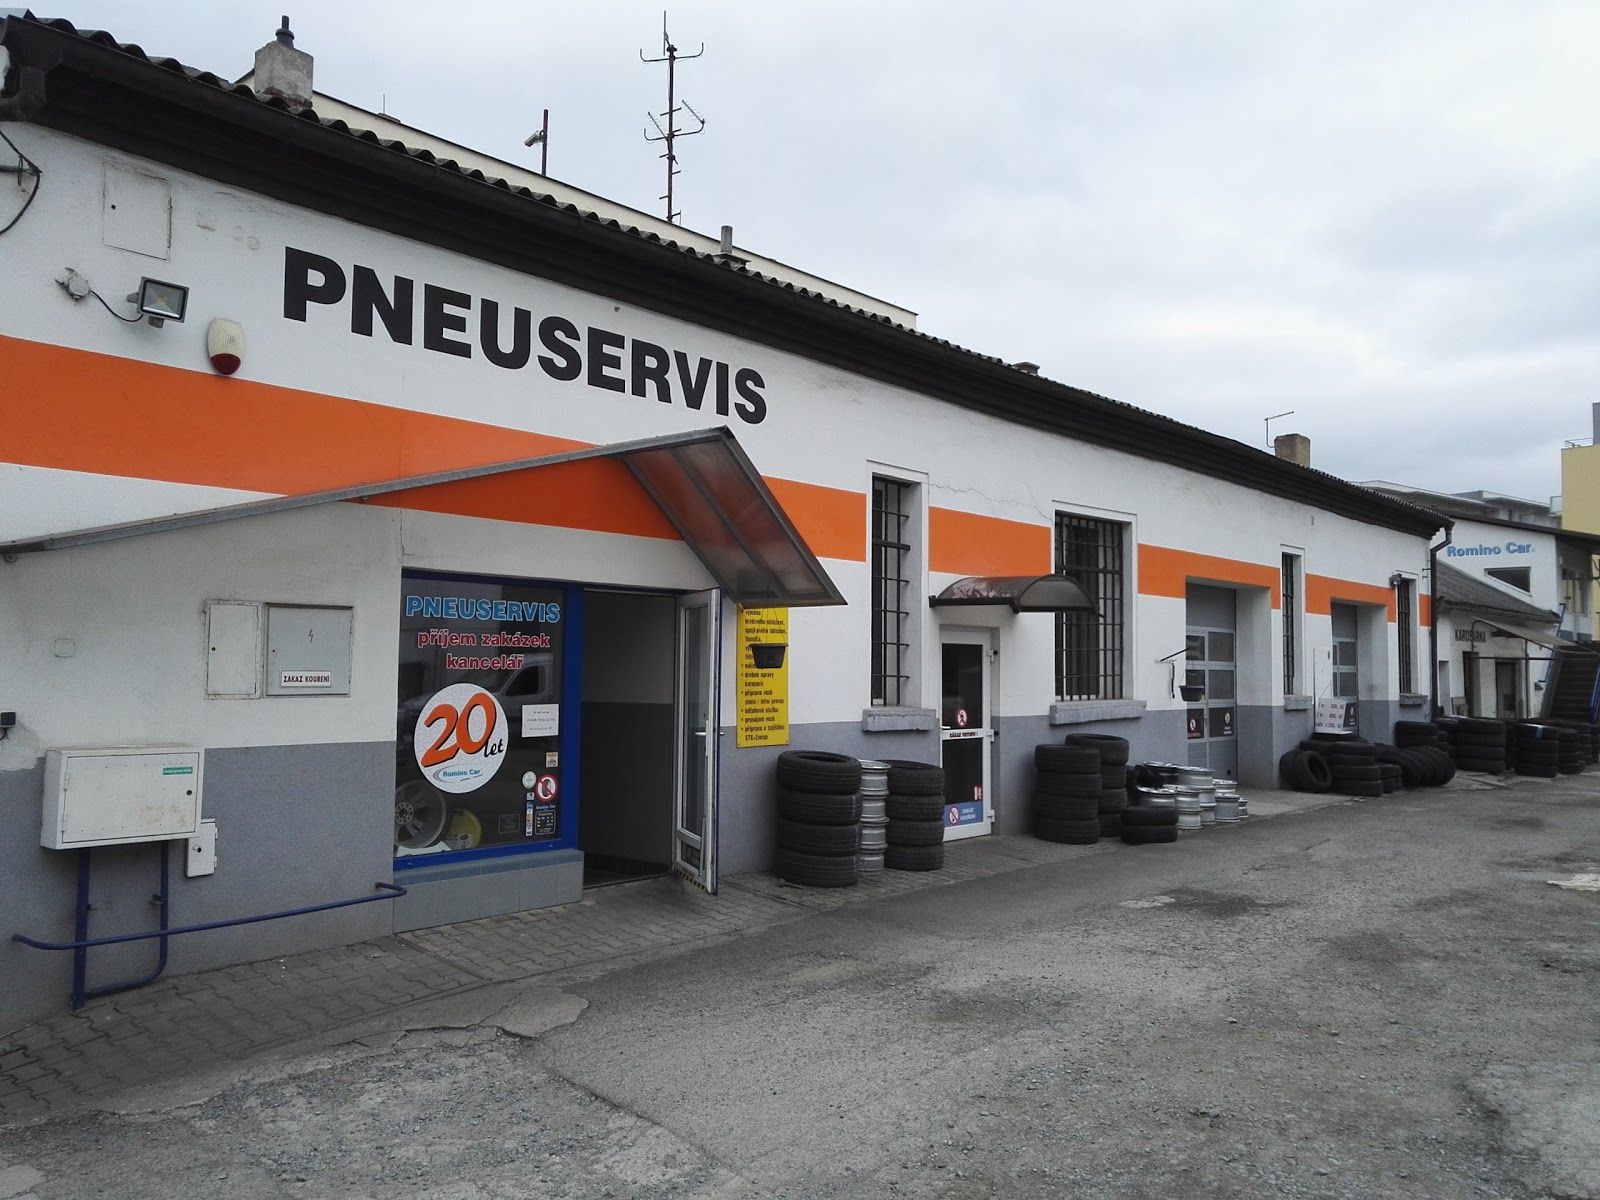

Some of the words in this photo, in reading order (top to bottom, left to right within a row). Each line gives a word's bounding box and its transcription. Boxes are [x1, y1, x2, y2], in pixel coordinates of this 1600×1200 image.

[284, 246, 767, 425] PNEUSERVIS
[1447, 544, 1502, 557] Romino
[1505, 542, 1532, 554] Car
[406, 595, 561, 623] PNEUSERVIS
[418, 629, 476, 648] příjem
[481, 631, 550, 648] zakázek
[446, 653, 525, 670] kancelář
[421, 692, 497, 768] 20
[484, 738, 503, 758] let
[443, 769, 468, 778] Romino
